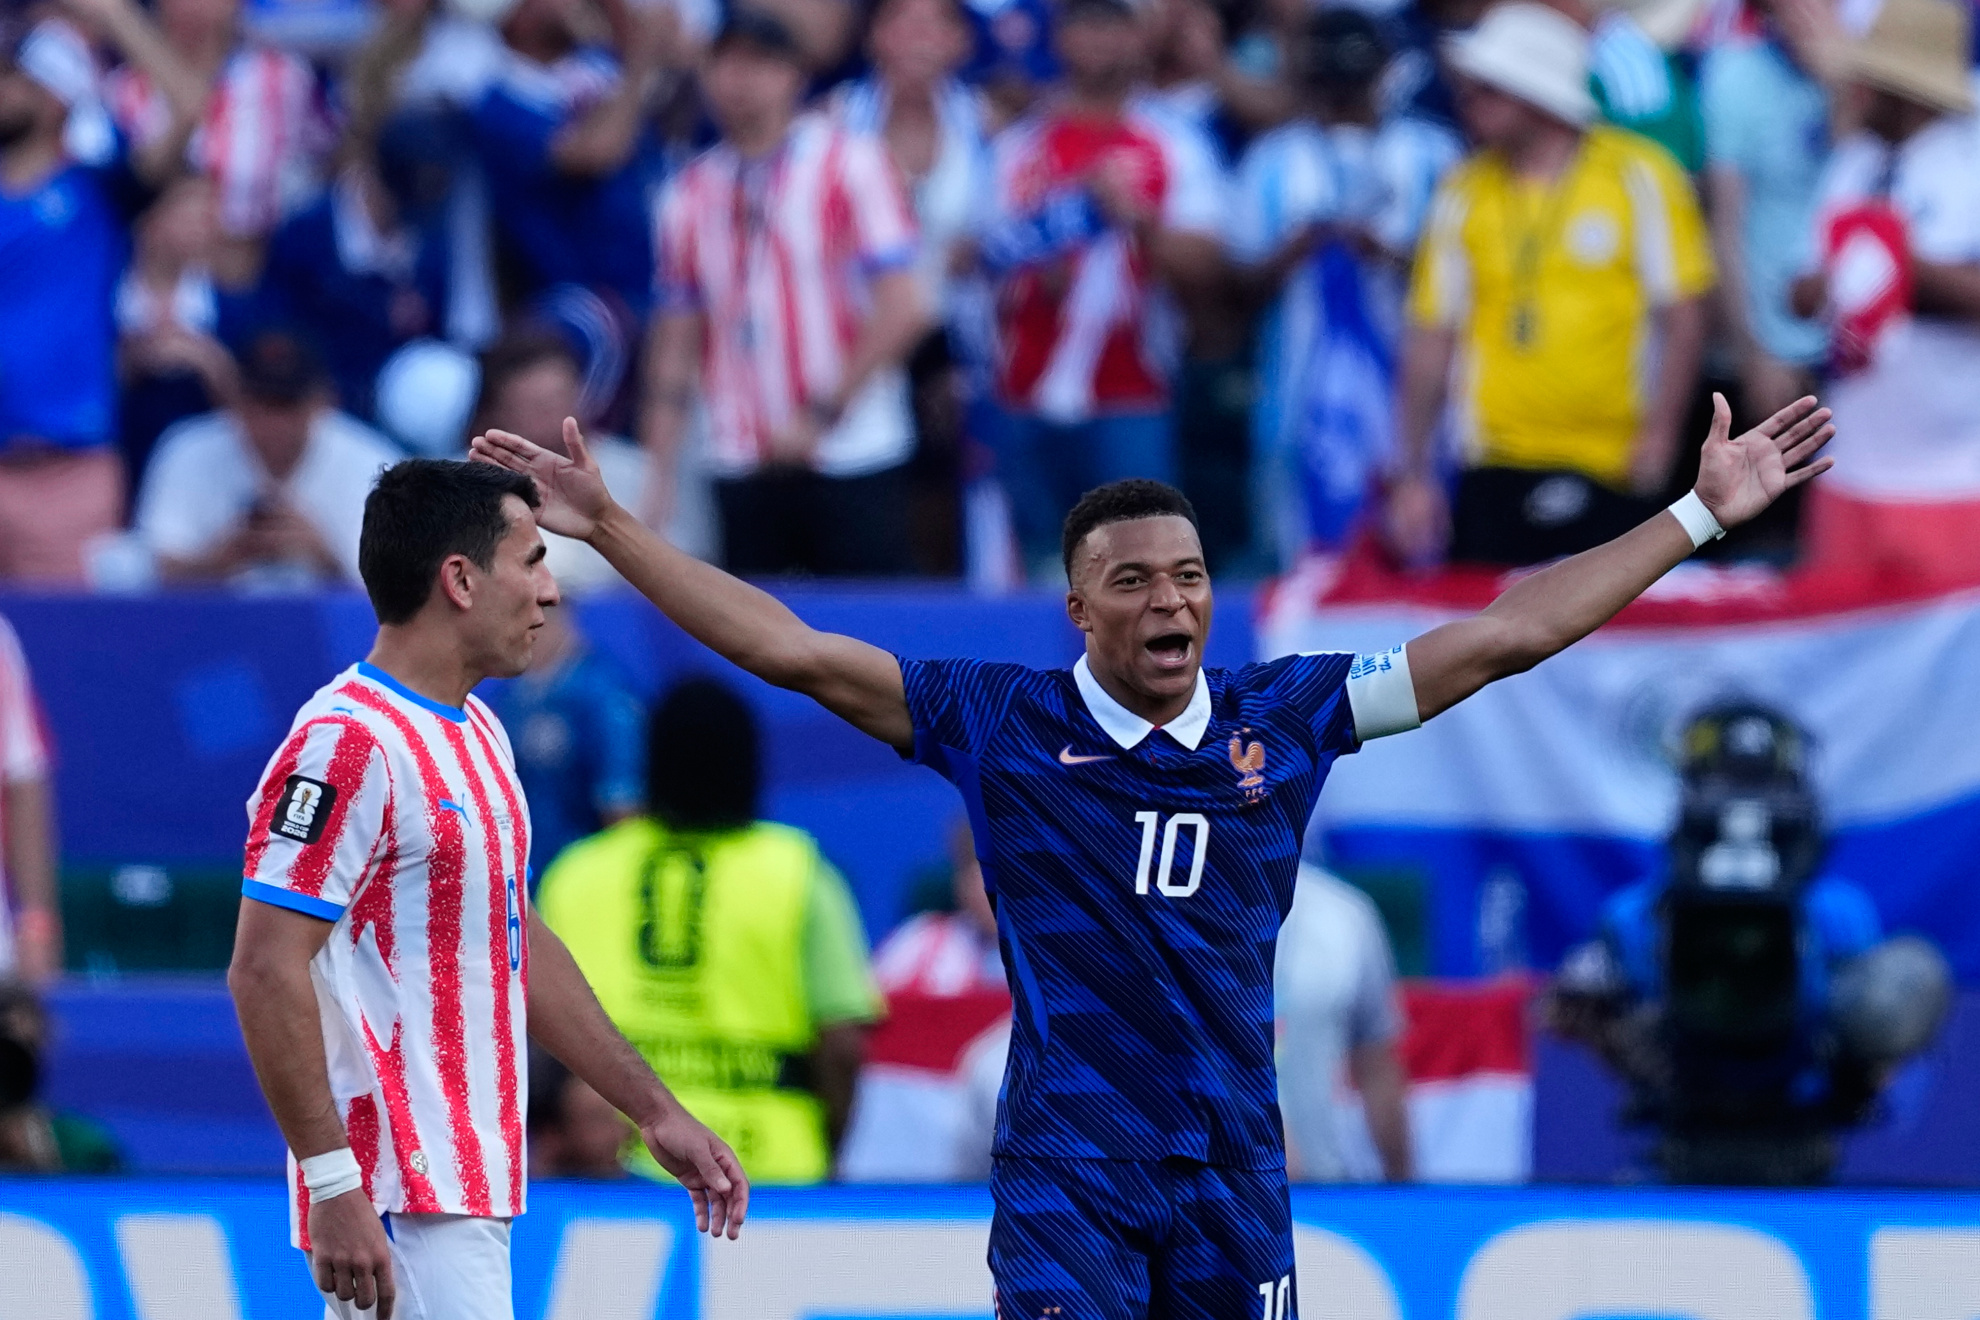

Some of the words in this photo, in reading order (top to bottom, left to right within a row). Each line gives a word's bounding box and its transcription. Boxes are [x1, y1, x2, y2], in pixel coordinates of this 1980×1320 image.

[281, 825, 307, 838] 2026
[1135, 811, 1209, 897] 10
[507, 876, 521, 974] 6
